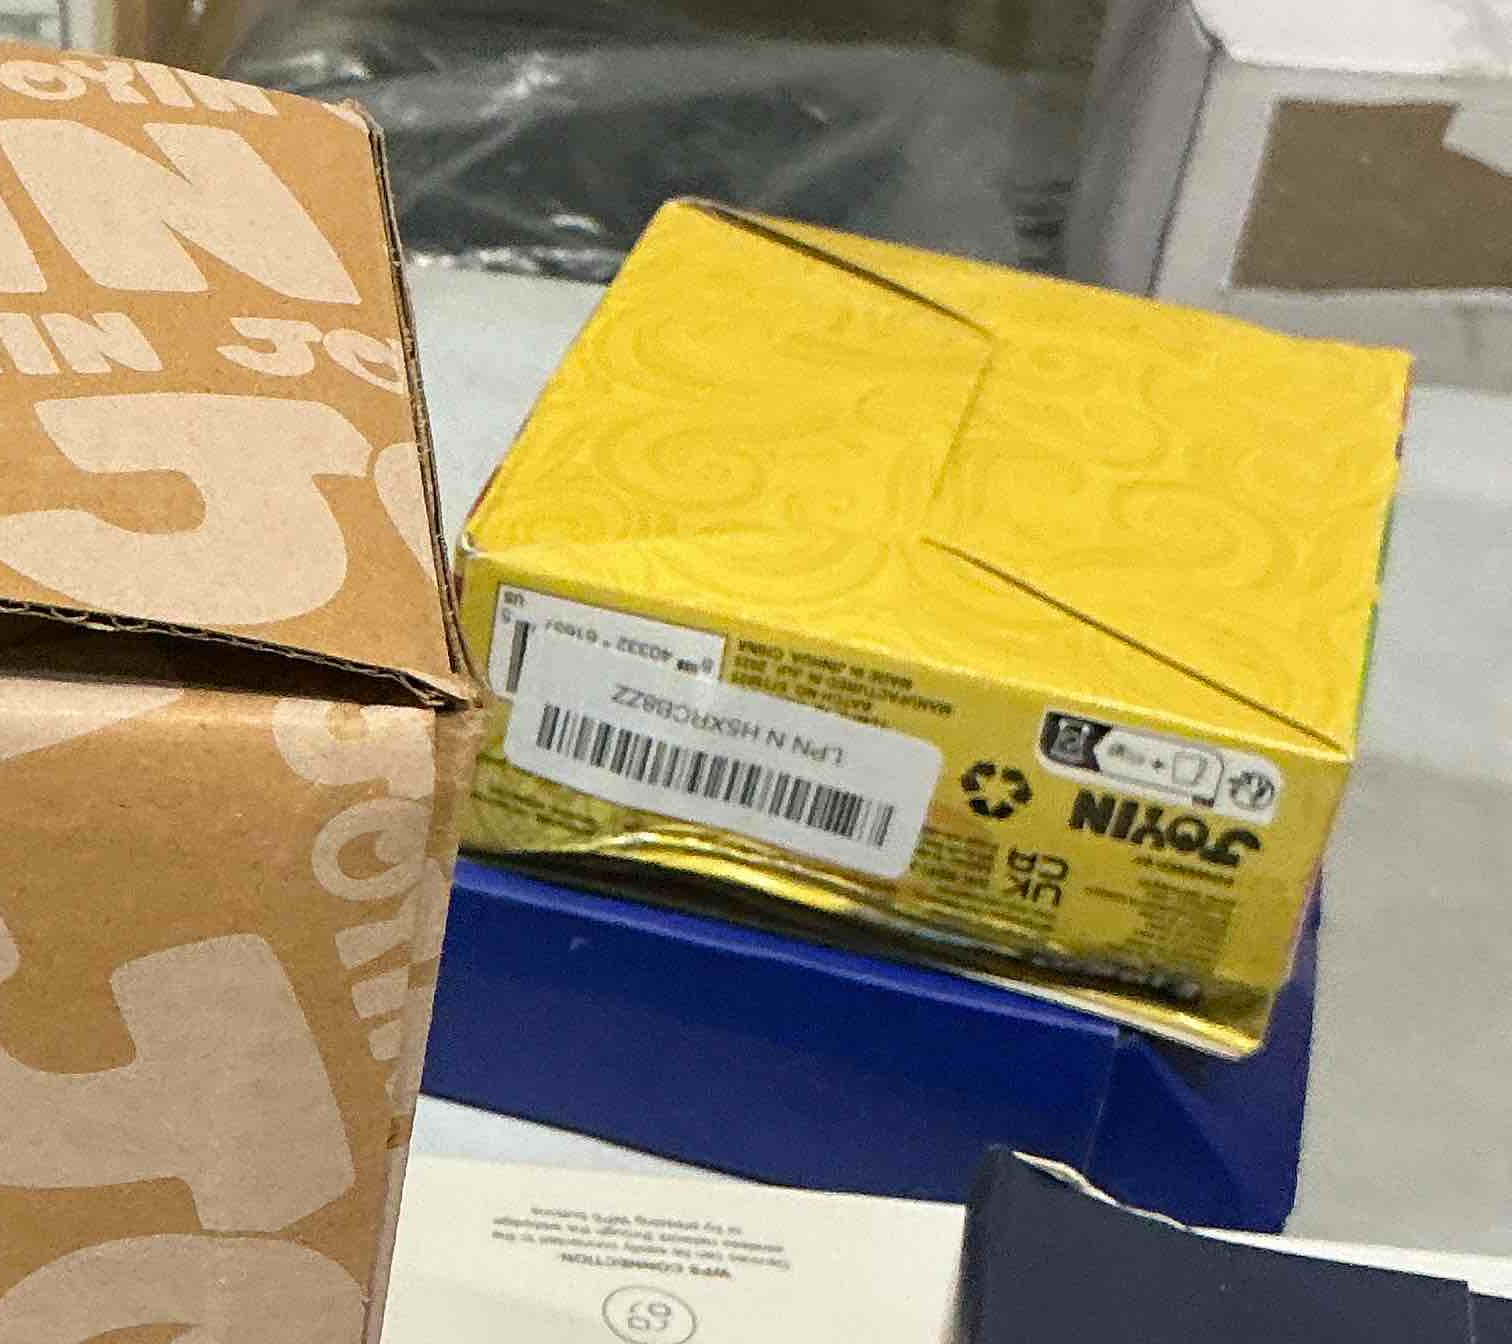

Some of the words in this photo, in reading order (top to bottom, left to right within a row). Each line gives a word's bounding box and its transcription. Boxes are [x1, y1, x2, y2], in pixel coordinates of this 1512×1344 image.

[765, 727, 786, 751] N
[792, 734, 844, 766] LPN
[1068, 787, 1262, 868] JOYIN
